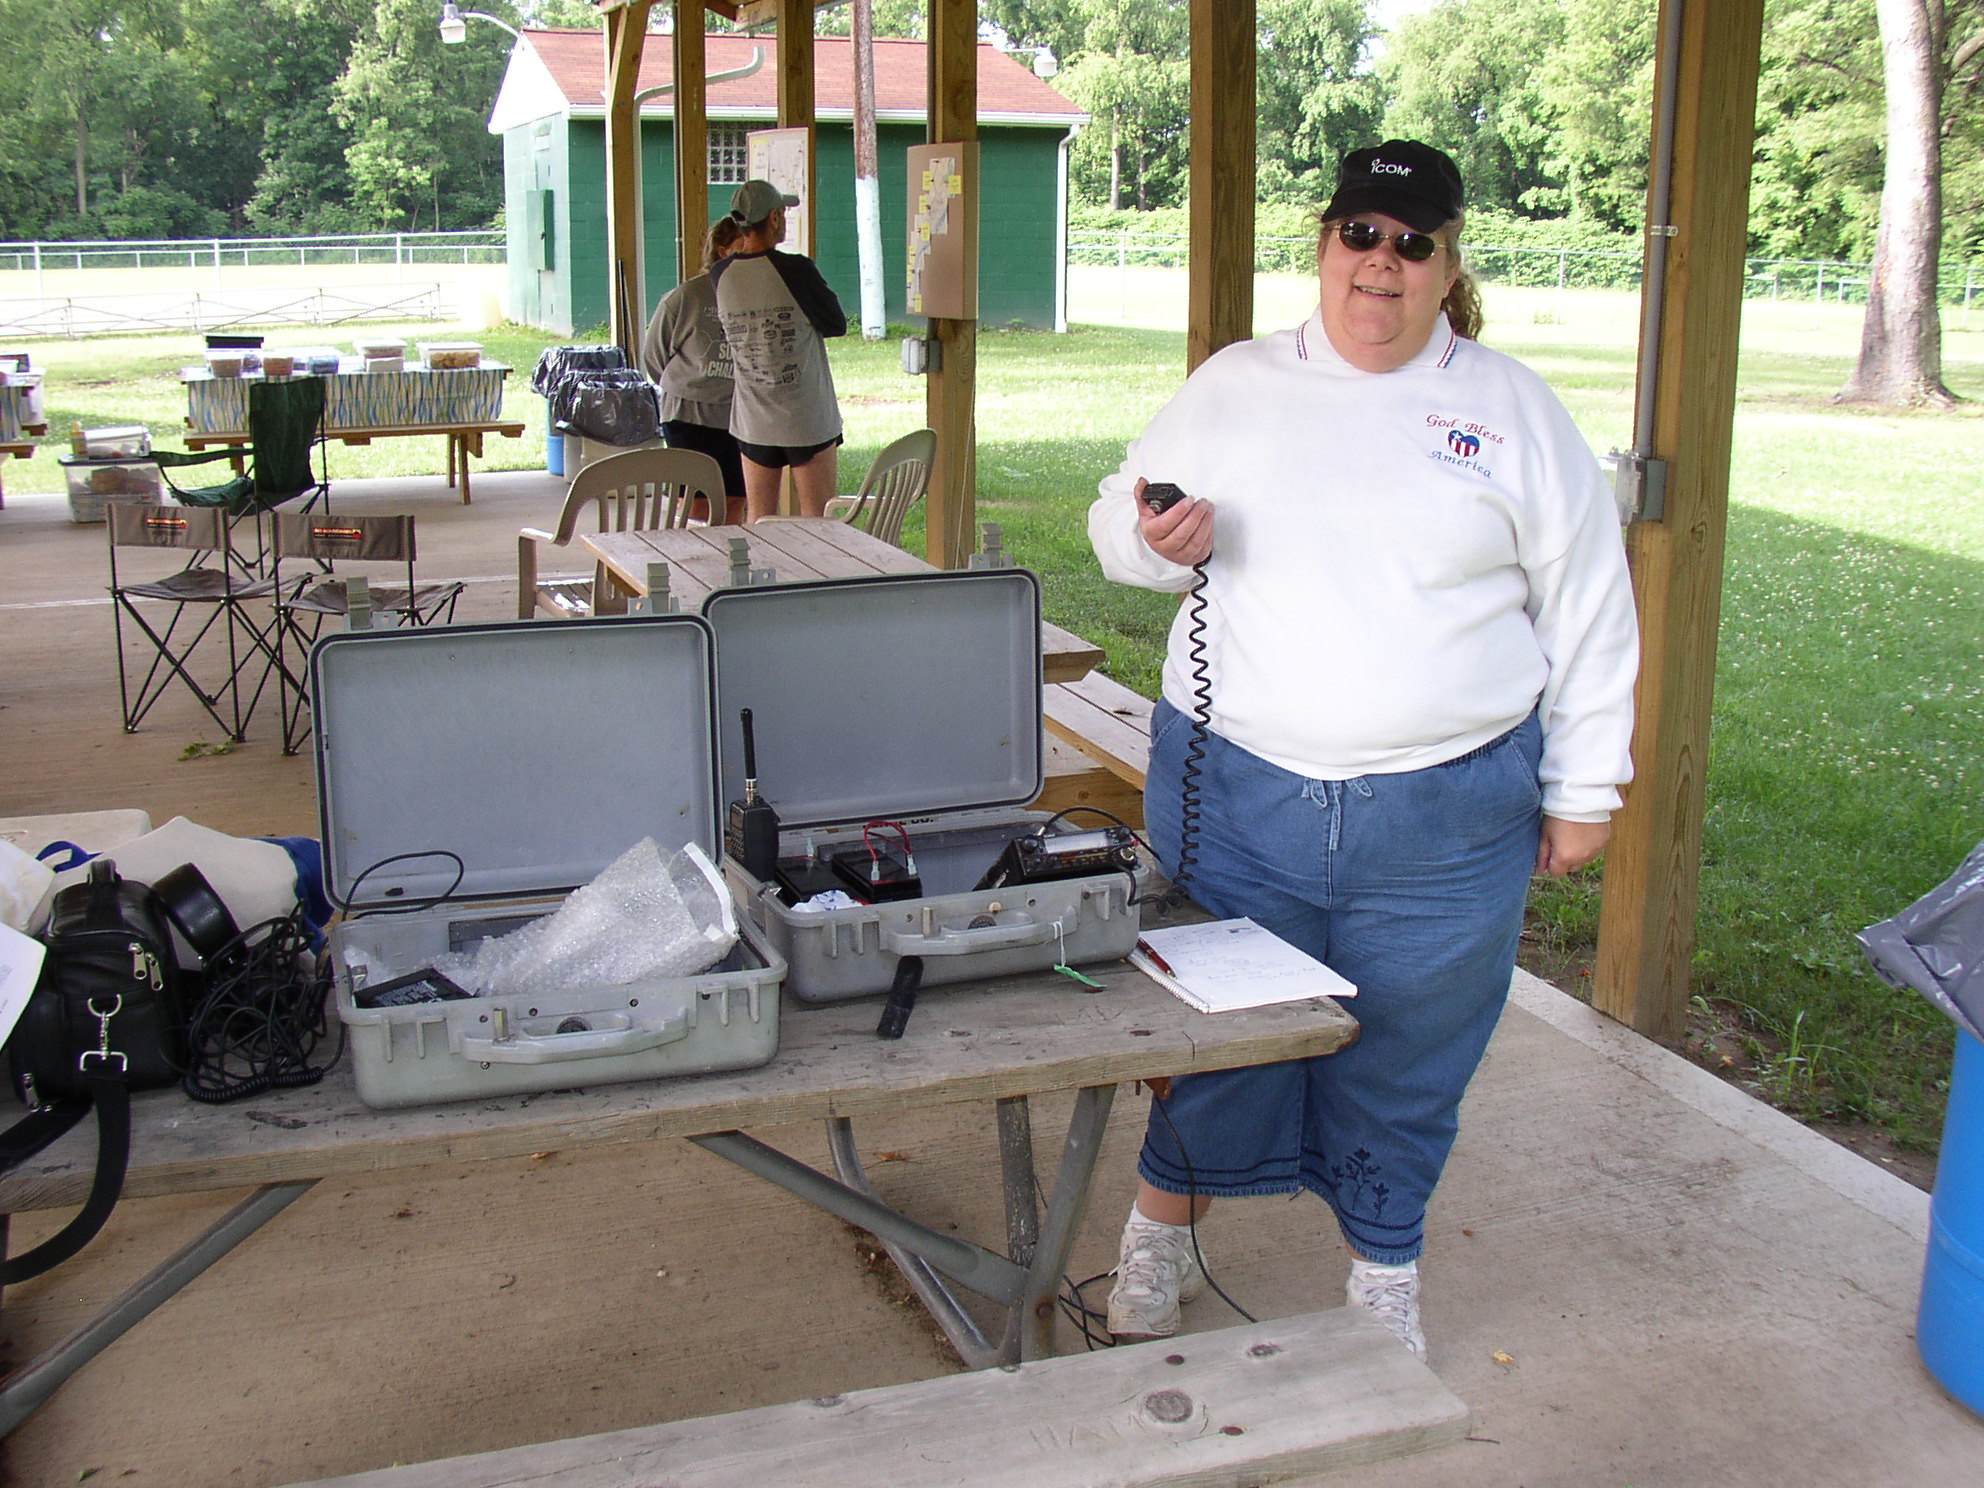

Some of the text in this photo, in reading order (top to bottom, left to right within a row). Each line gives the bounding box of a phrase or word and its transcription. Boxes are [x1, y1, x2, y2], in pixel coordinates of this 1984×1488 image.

[1426, 414, 1505, 444] God Bless
[1427, 450, 1491, 479] America
